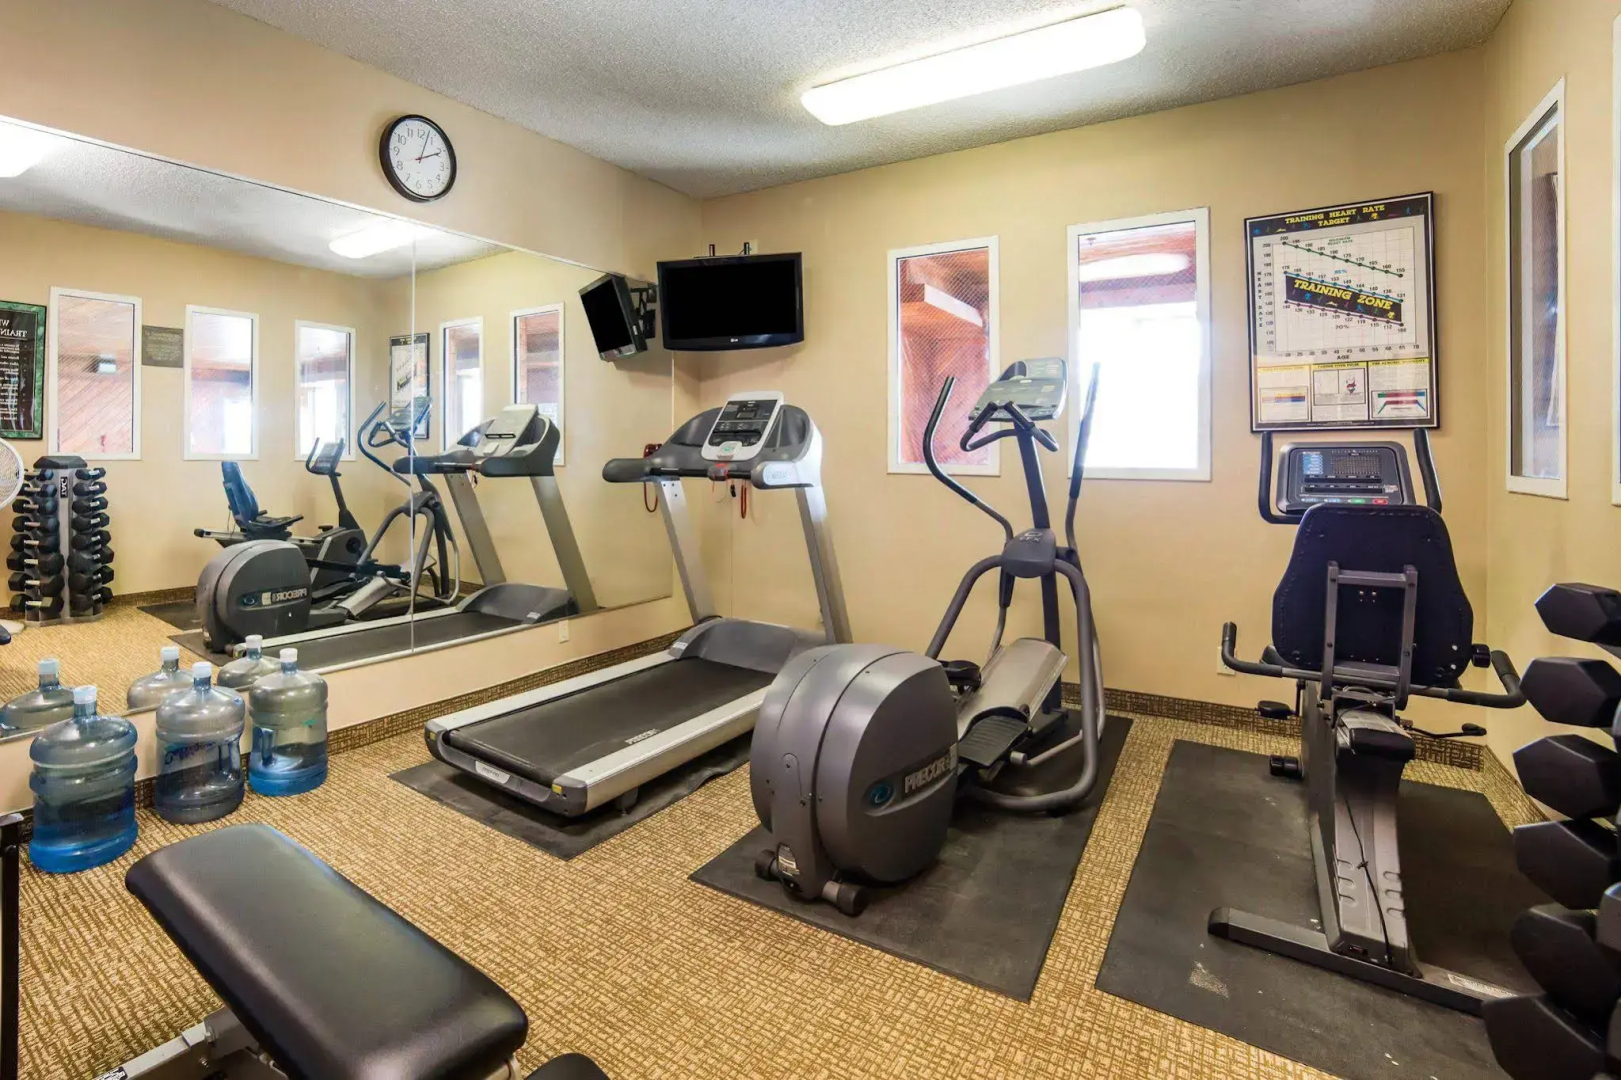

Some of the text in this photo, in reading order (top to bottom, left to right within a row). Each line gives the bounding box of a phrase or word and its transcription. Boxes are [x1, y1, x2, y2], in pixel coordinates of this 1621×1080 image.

[407, 127, 414, 138] 11
[417, 128, 425, 139] 12
[397, 133, 407, 145] 10
[430, 136, 434, 145] 1
[393, 146, 400, 156] 9
[396, 160, 404, 170] 8
[440, 162, 445, 171] 3
[405, 173, 411, 182] 7
[435, 173, 441, 181] 4
[415, 179, 422, 189] 6
[427, 179, 434, 189] 5
[1285, 205, 1385, 225] TRAINING HEART RATE
[1318, 217, 1350, 227] TARGET
[1294, 279, 1394, 310] TRAINING ZONE
[905, 756, 946, 793] PRECOR
